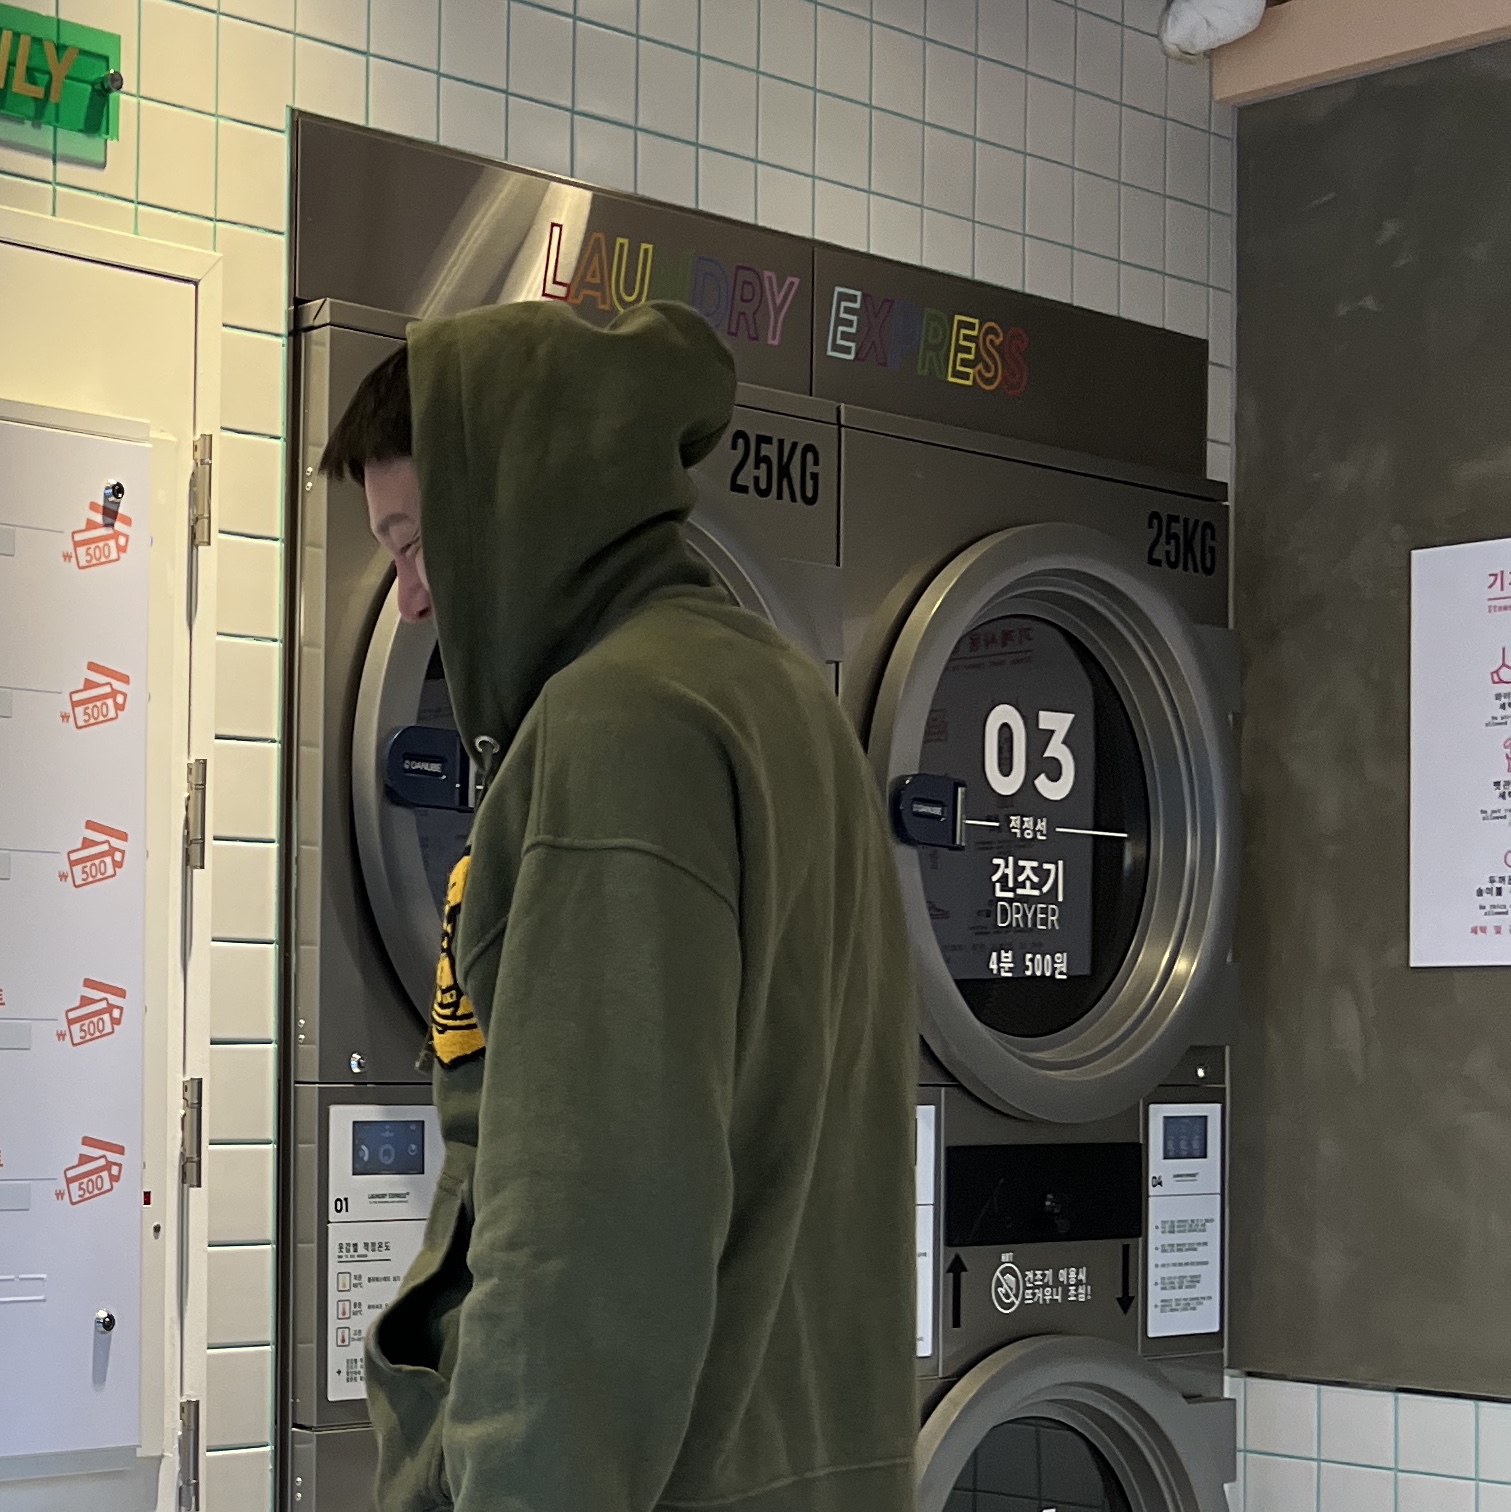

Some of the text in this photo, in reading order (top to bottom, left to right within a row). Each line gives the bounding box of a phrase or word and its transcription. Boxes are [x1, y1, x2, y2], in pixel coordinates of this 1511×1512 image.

[826, 286, 1029, 396] EXPRESS
[730, 431, 819, 506] 25KG
[85, 542, 112, 564] 500
[1147, 511, 1216, 576] 25KG
[82, 701, 110, 724] 500
[983, 704, 1076, 801] 03
[1009, 815, 1047, 839] 적정선
[81, 859, 108, 882] 500
[991, 856, 1063, 901] 건조기
[997, 901, 1059, 930] DRYER
[988, 950, 1068, 979] 4분 500원
[79, 1017, 106, 1041] 500
[77, 1174, 105, 1199] 500
[334, 1197, 349, 1213] 01
[1025, 1267, 1086, 1287] 건조기 이용시
[1024, 1285, 1091, 1304] 뜨거우니 조심!
